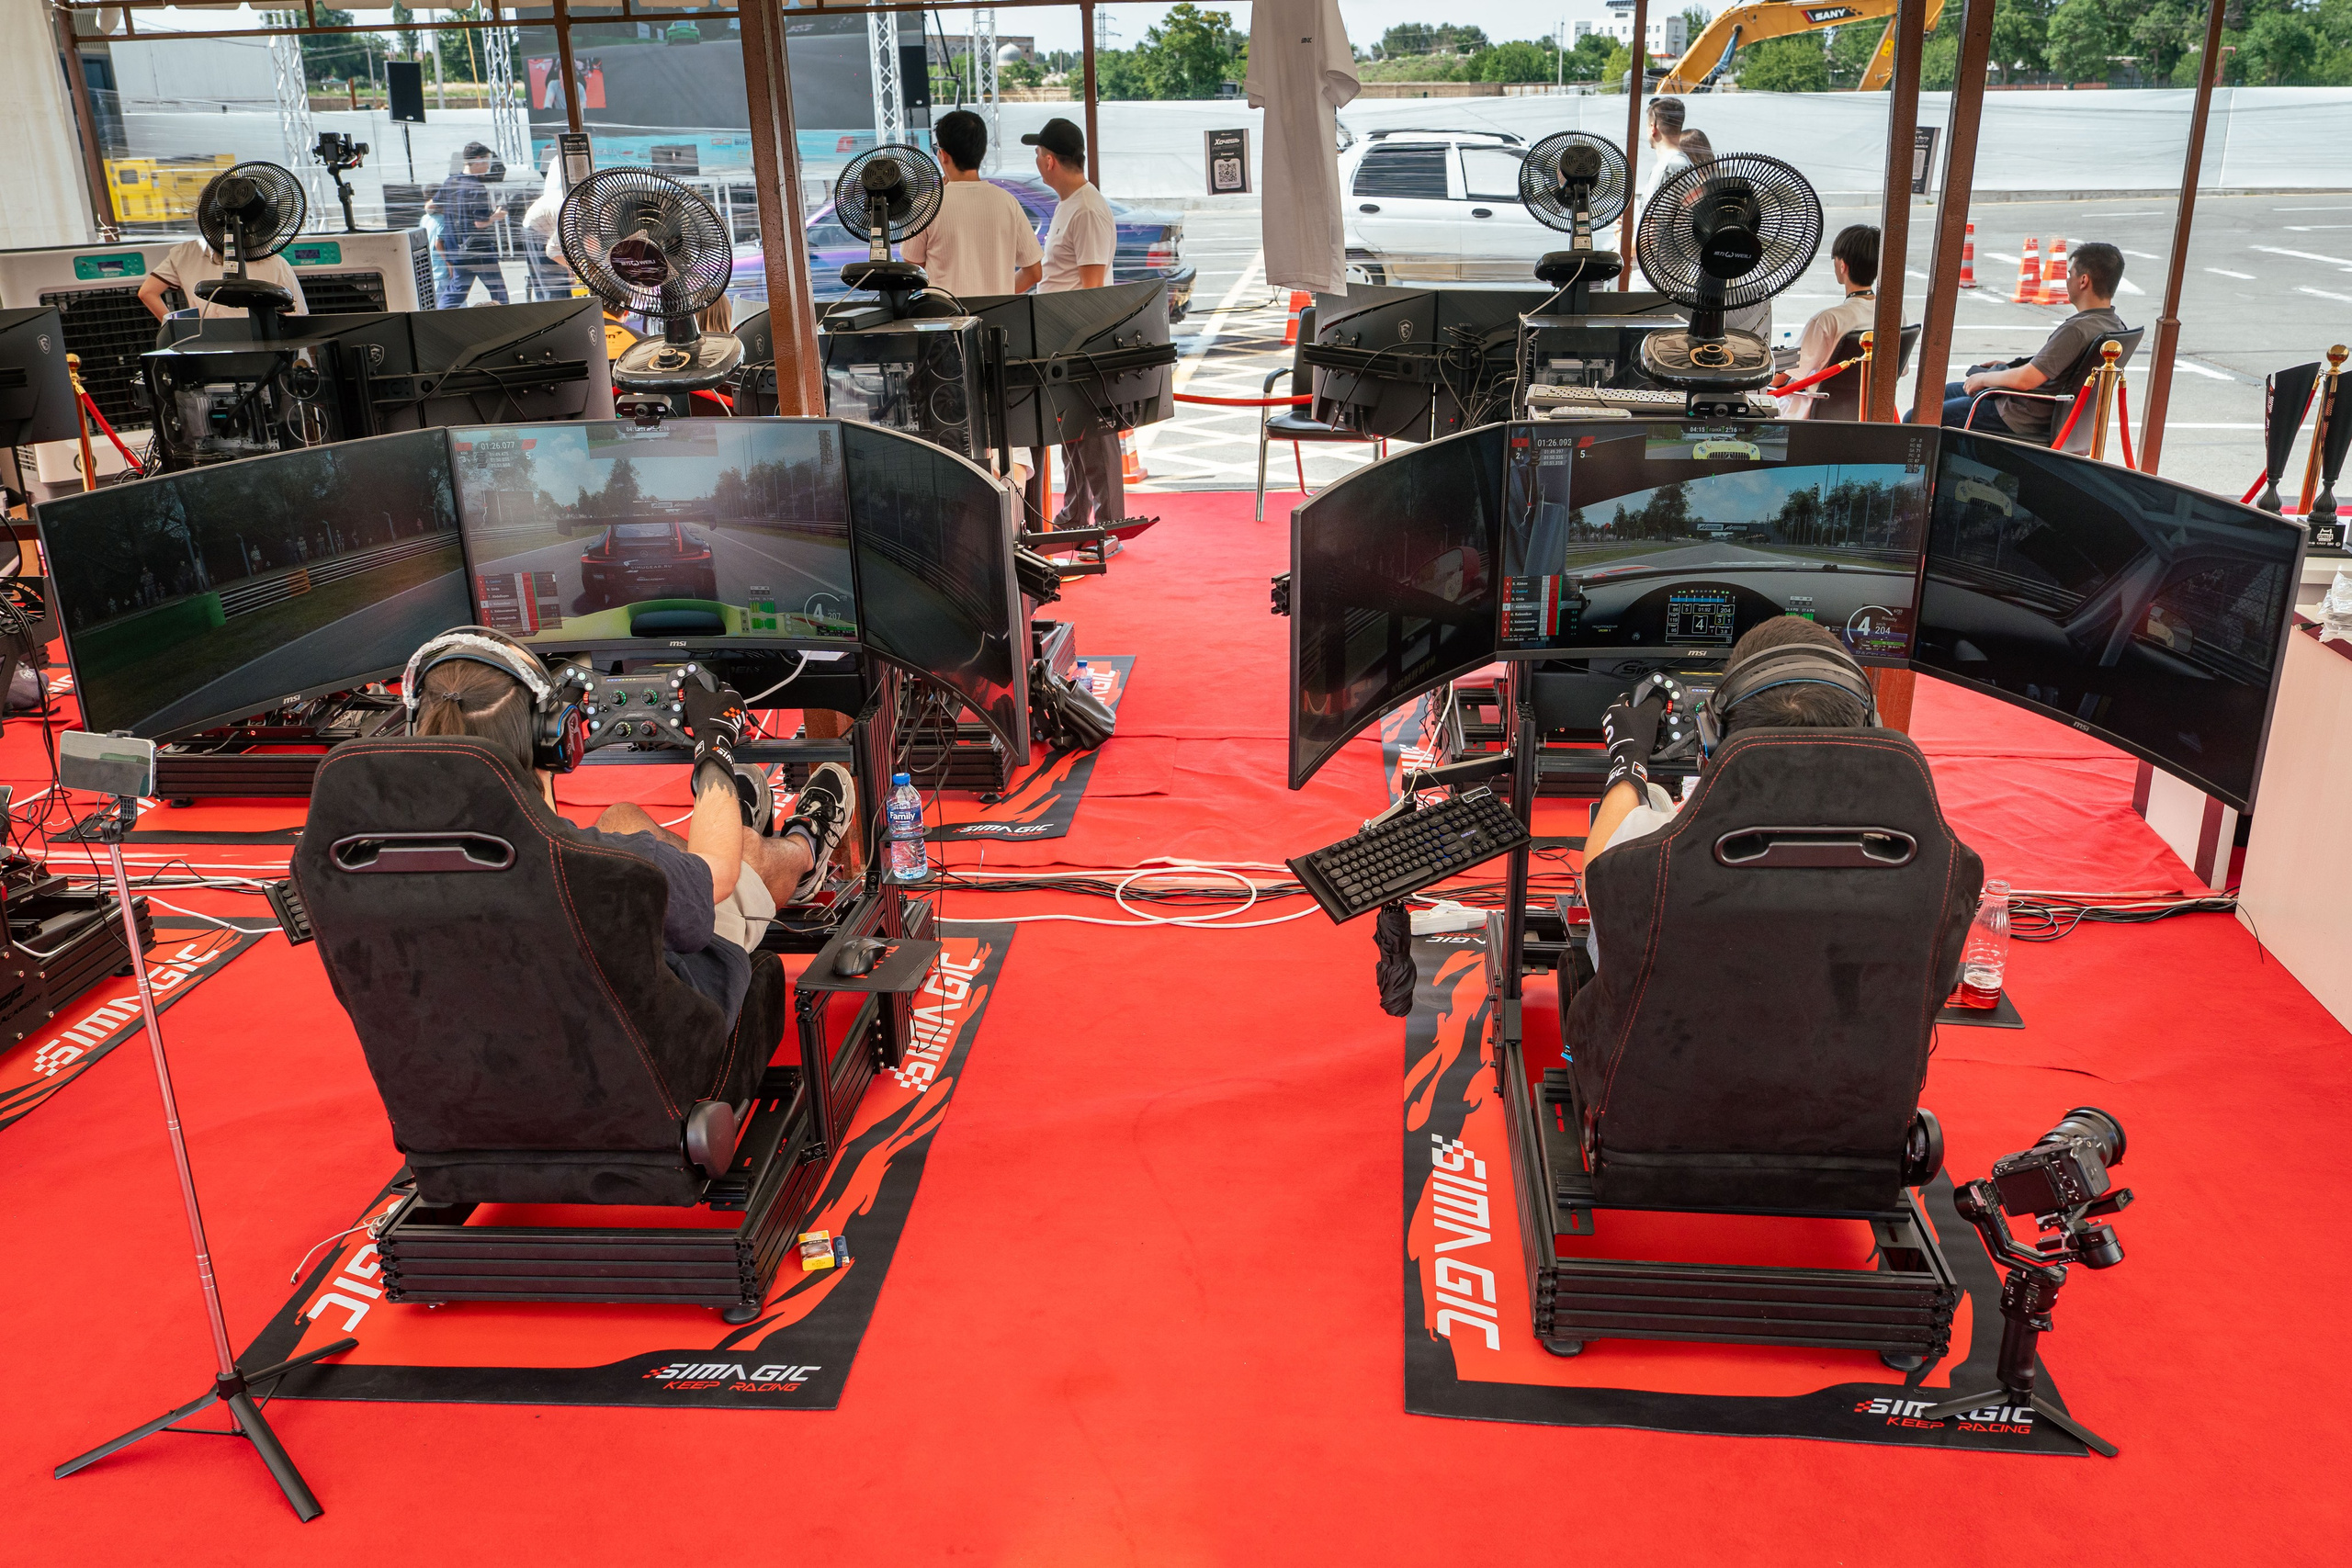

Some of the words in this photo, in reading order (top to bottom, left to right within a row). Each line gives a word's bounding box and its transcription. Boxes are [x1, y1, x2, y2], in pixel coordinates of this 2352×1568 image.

[1815, 7, 1847, 21] SANY
[481, 441, 515, 450] 01:26.077
[1537, 438, 1572, 447] 01:26.092
[525, 451, 531, 460] 5
[1579, 449, 1586, 458] 5
[813, 603, 824, 622] 4
[827, 612, 842, 621] 207
[1695, 618, 1704, 631] 4
[1857, 616, 1871, 636] 4
[1874, 626, 1891, 635] 204
[283, 694, 301, 705] msi
[2073, 720, 2090, 732] msi
[889, 811, 916, 822] Family
[958, 823, 1055, 834] SIMAGIC
[1431, 1133, 1501, 1351] SIMAGIC
[654, 1363, 822, 1382] SIMAGIC
[662, 1381, 721, 1390] KEEP
[729, 1382, 802, 1392] RACING
[1868, 1397, 2036, 1424] SIMGIC
[1886, 1416, 1945, 1429] KEEP
[1957, 1422, 2032, 1435] RACING
